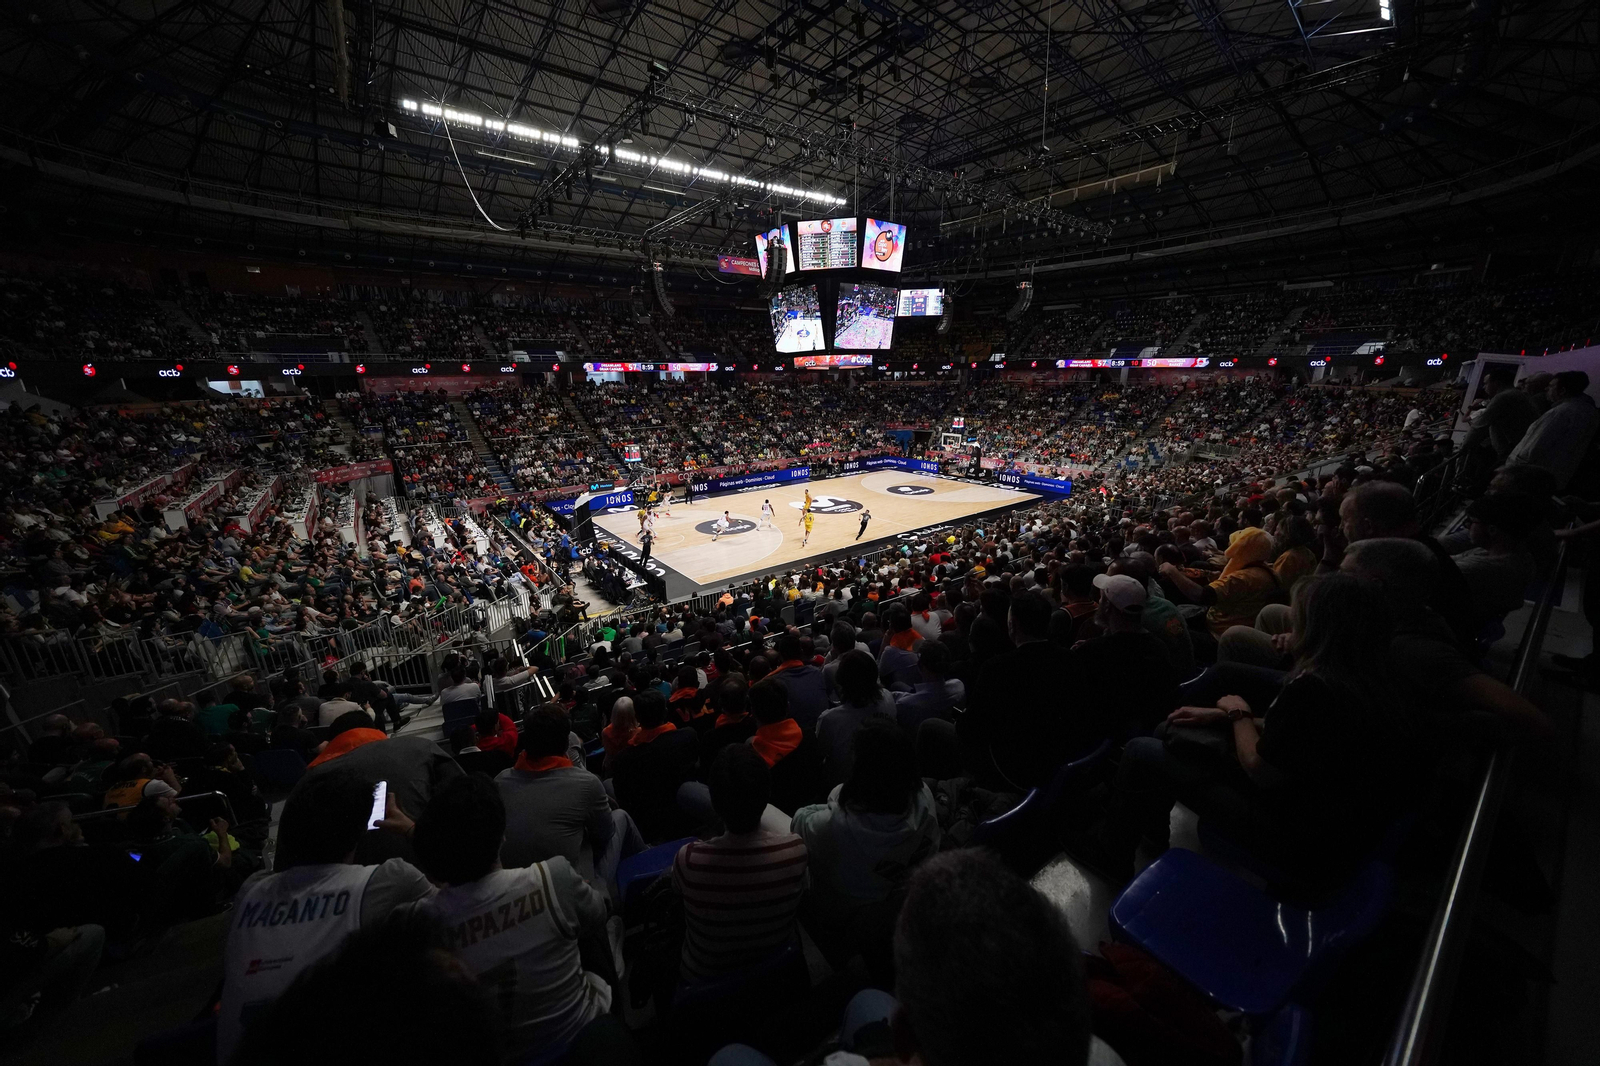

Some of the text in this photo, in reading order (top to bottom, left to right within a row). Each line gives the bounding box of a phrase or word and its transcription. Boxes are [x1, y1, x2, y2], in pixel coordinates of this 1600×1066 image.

[731, 259, 756, 267] CAMPEONES
[1427, 357, 1443, 365] acb
[0, 366, 15, 377] cb
[159, 369, 181, 377] acb
[844, 462, 859, 470] IONOS
[920, 462, 937, 471] IONOS
[691, 482, 708, 492] NOS
[791, 468, 809, 478] IONOS
[999, 473, 1020, 484] IONOS
[606, 493, 632, 505] IONOS
[237, 890, 350, 929] MAGANTO
[450, 889, 545, 948] MPAZZO
